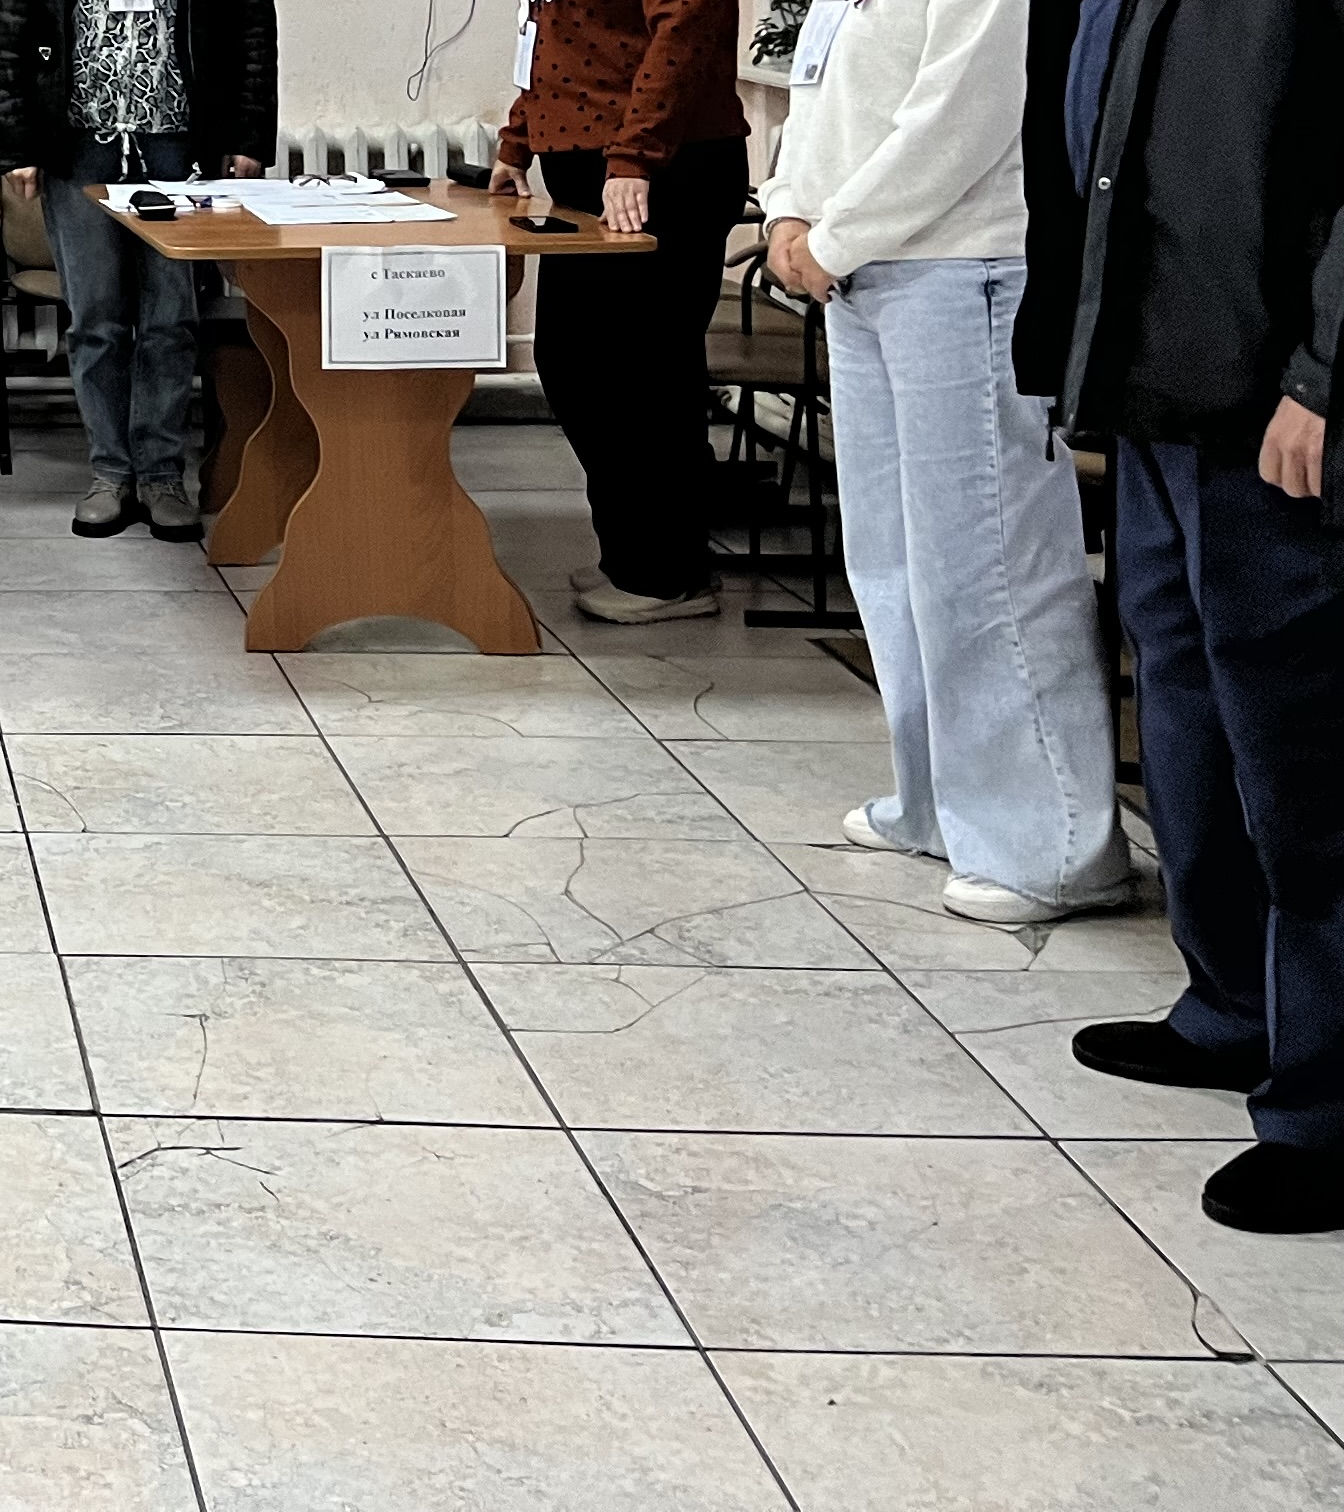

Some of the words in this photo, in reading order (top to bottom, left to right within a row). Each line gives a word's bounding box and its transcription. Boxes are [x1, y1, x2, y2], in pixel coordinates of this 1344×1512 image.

[383, 268, 446, 280] Таскаево
[362, 311, 380, 322] ул
[384, 308, 467, 320] Поселковая
[362, 331, 380, 342] ул
